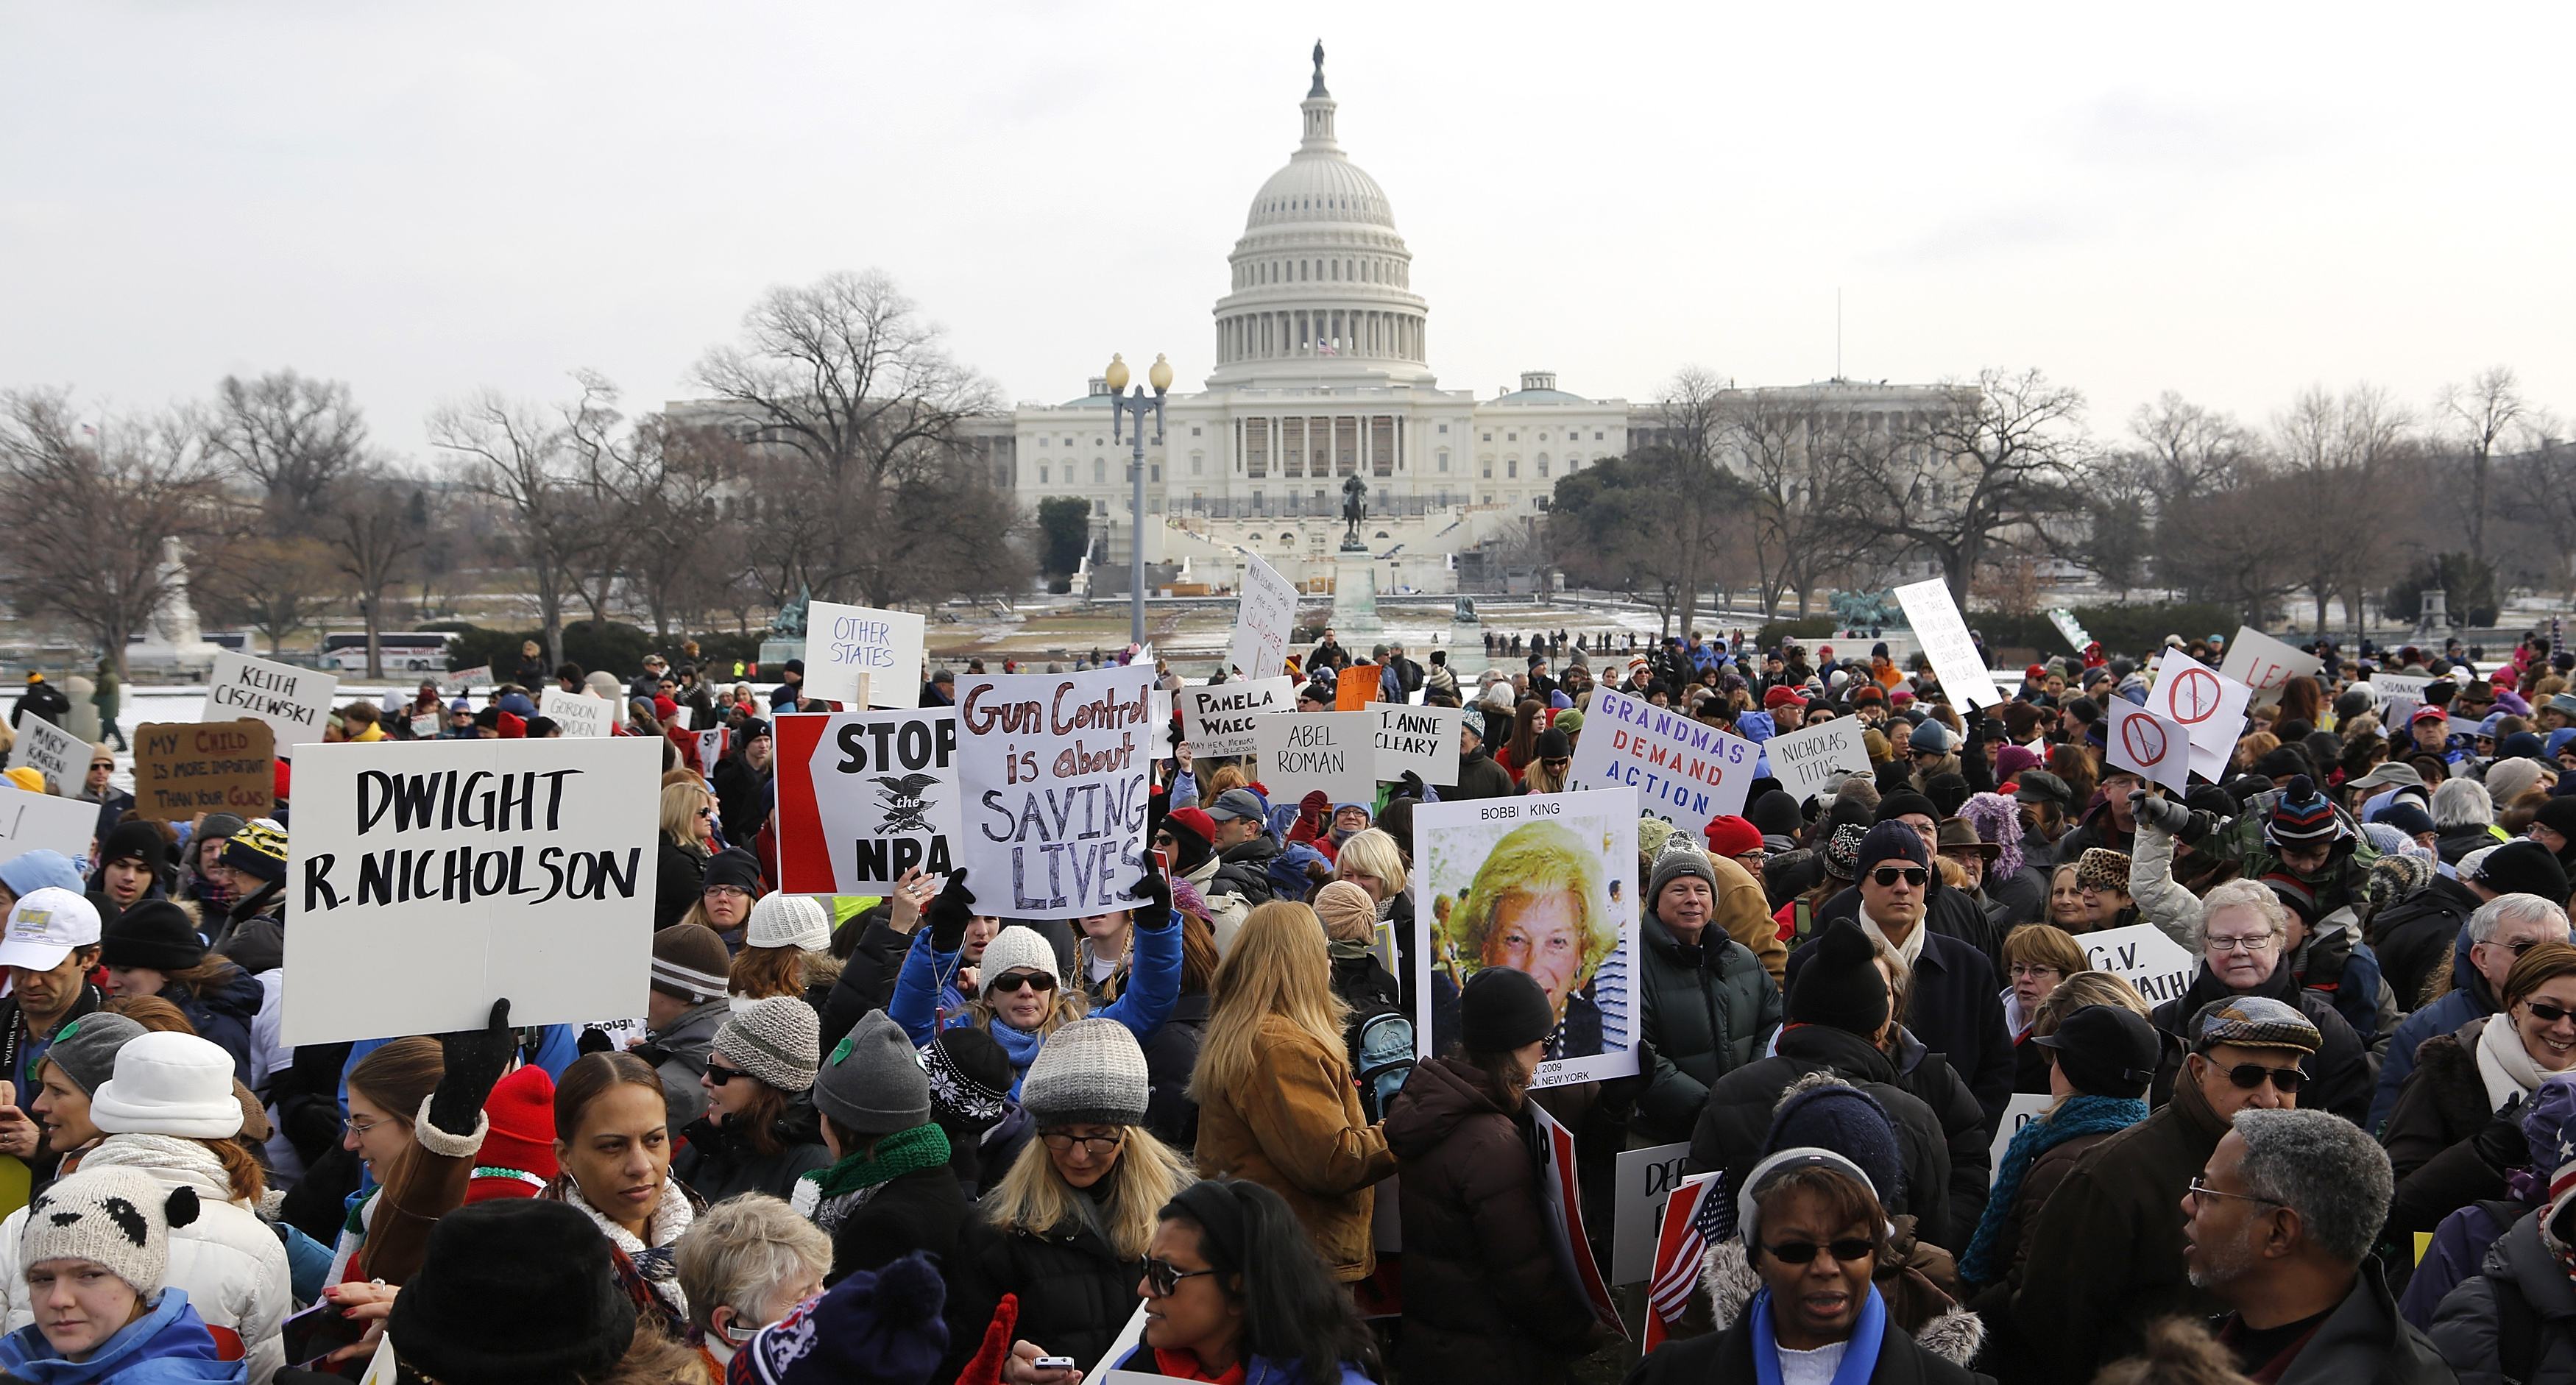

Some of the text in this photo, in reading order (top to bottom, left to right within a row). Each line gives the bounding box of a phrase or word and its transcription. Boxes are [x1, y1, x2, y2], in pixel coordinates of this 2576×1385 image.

[834, 617, 890, 645] OTHER
[1247, 606, 1283, 655] SLAUGHTER
[830, 642, 894, 667] STATES
[239, 665, 297, 697] KEITH
[214, 684, 315, 726] CISZEWSKI
[550, 698, 597, 719] GORDON
[963, 683, 1042, 736] Gun
[1051, 681, 1148, 736] Control
[1195, 690, 1273, 714] PAMELA
[1287, 725, 1337, 748] ABEL
[1381, 710, 1443, 735] T. ANNE
[1602, 694, 1745, 764] GRANDMAS
[32, 725, 70, 755] MARY
[149, 730, 247, 756] MY CHILD
[836, 718, 957, 773] STOP
[1188, 737, 1254, 750] MAY HER MEMORY
[1224, 745, 1257, 754] BLESSIN
[1375, 732, 1438, 757] CLEARY
[1782, 732, 1847, 763] NICHOLAS
[26, 743, 68, 773] KAREN
[152, 759, 266, 779] IS MORE IMPORTANT
[1006, 732, 1135, 785] is about
[1278, 750, 1344, 774] ROMAN
[1613, 729, 1724, 787] DEMAND
[154, 785, 265, 808] THAN YOUR GUNS
[356, 769, 584, 836] DWIGHT
[896, 796, 920, 808] the
[1606, 760, 1709, 816] ACTION
[981, 773, 1148, 843] SAVING
[1481, 802, 1560, 820] BOBBI KING
[856, 835, 952, 882] NRA
[1011, 836, 1144, 910] LIVES
[357, 846, 642, 907] NICHOLSON
[4, 1031, 15, 1066] DIGITAL
[1542, 1063, 1562, 1073] 2009
[1542, 1074, 1563, 1085] NEW
[1565, 1071, 1590, 1082] YORK
